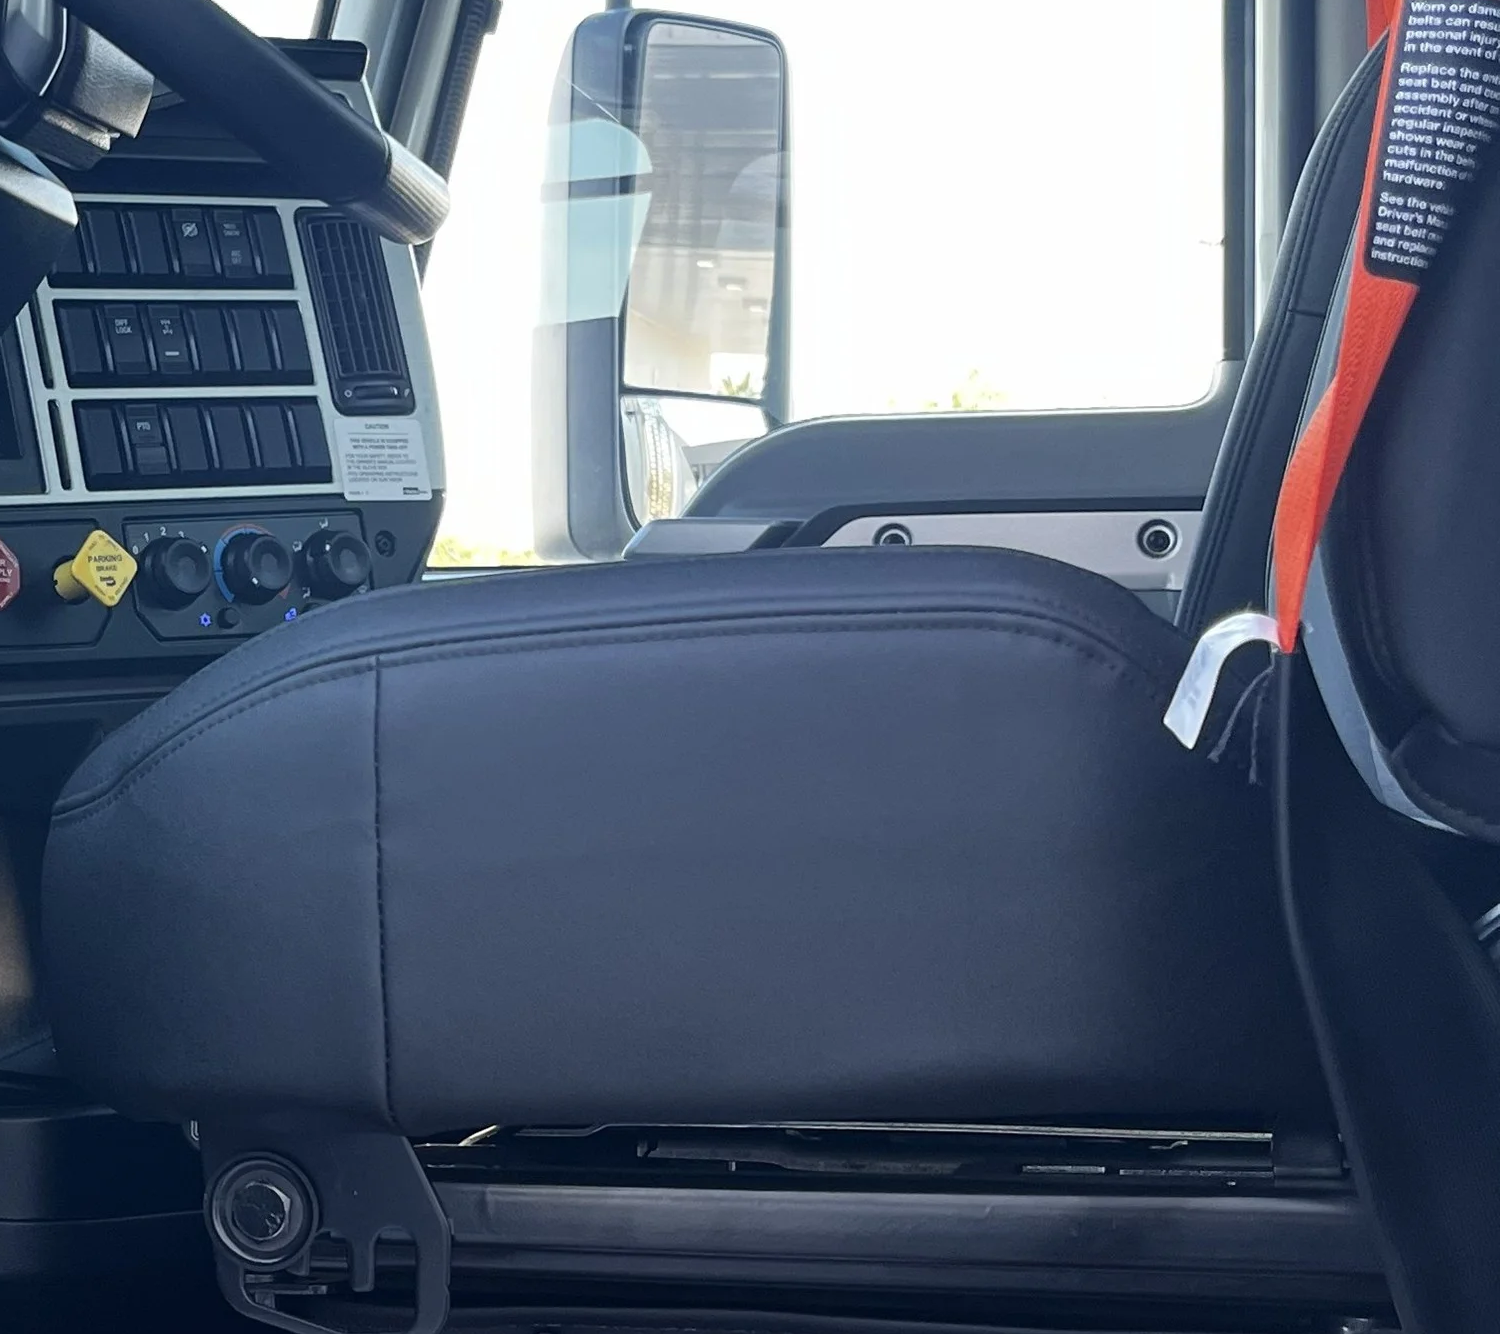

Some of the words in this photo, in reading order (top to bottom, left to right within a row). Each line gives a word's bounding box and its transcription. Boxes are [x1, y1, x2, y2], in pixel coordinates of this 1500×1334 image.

[1411, 2, 1445, 12] Worn
[1449, 4, 1465, 12] or
[1408, 15, 1442, 26] belts
[1445, 17, 1470, 27] can
[1406, 30, 1467, 41] personal
[1404, 42, 1416, 52] in
[1420, 42, 1442, 53] the
[1445, 44, 1482, 57] event
[1485, 48, 1497, 60] of
[1401, 62, 1456, 76] Replace
[1460, 67, 1480, 80] the
[1398, 78, 1427, 87] seat
[1431, 78, 1457, 91] belt
[1459, 84, 1482, 95] and
[1395, 91, 1460, 107] assembly
[1462, 98, 1489, 112] after
[1394, 104, 1452, 118] accident
[1455, 112, 1468, 120] or
[1391, 118, 1440, 130] regular
[1389, 130, 1433, 144] shows
[1436, 137, 1465, 149] wear
[1387, 145, 1417, 157] cuts
[1420, 147, 1432, 158] in
[1435, 150, 1454, 162] the
[1385, 158, 1457, 179] malfunction
[1380, 192, 1404, 205] See
[1407, 196, 1427, 209] the
[1378, 206, 1424, 223] Driver's
[1376, 222, 1401, 234] seat
[1403, 225, 1426, 239] belt
[1373, 235, 1396, 247] and
[137, 422, 151, 430] PTO
[144, 532, 149, 542] 1
[160, 527, 166, 536] 2
[132, 545, 139, 555] 0
[87, 554, 123, 563] PARKING
